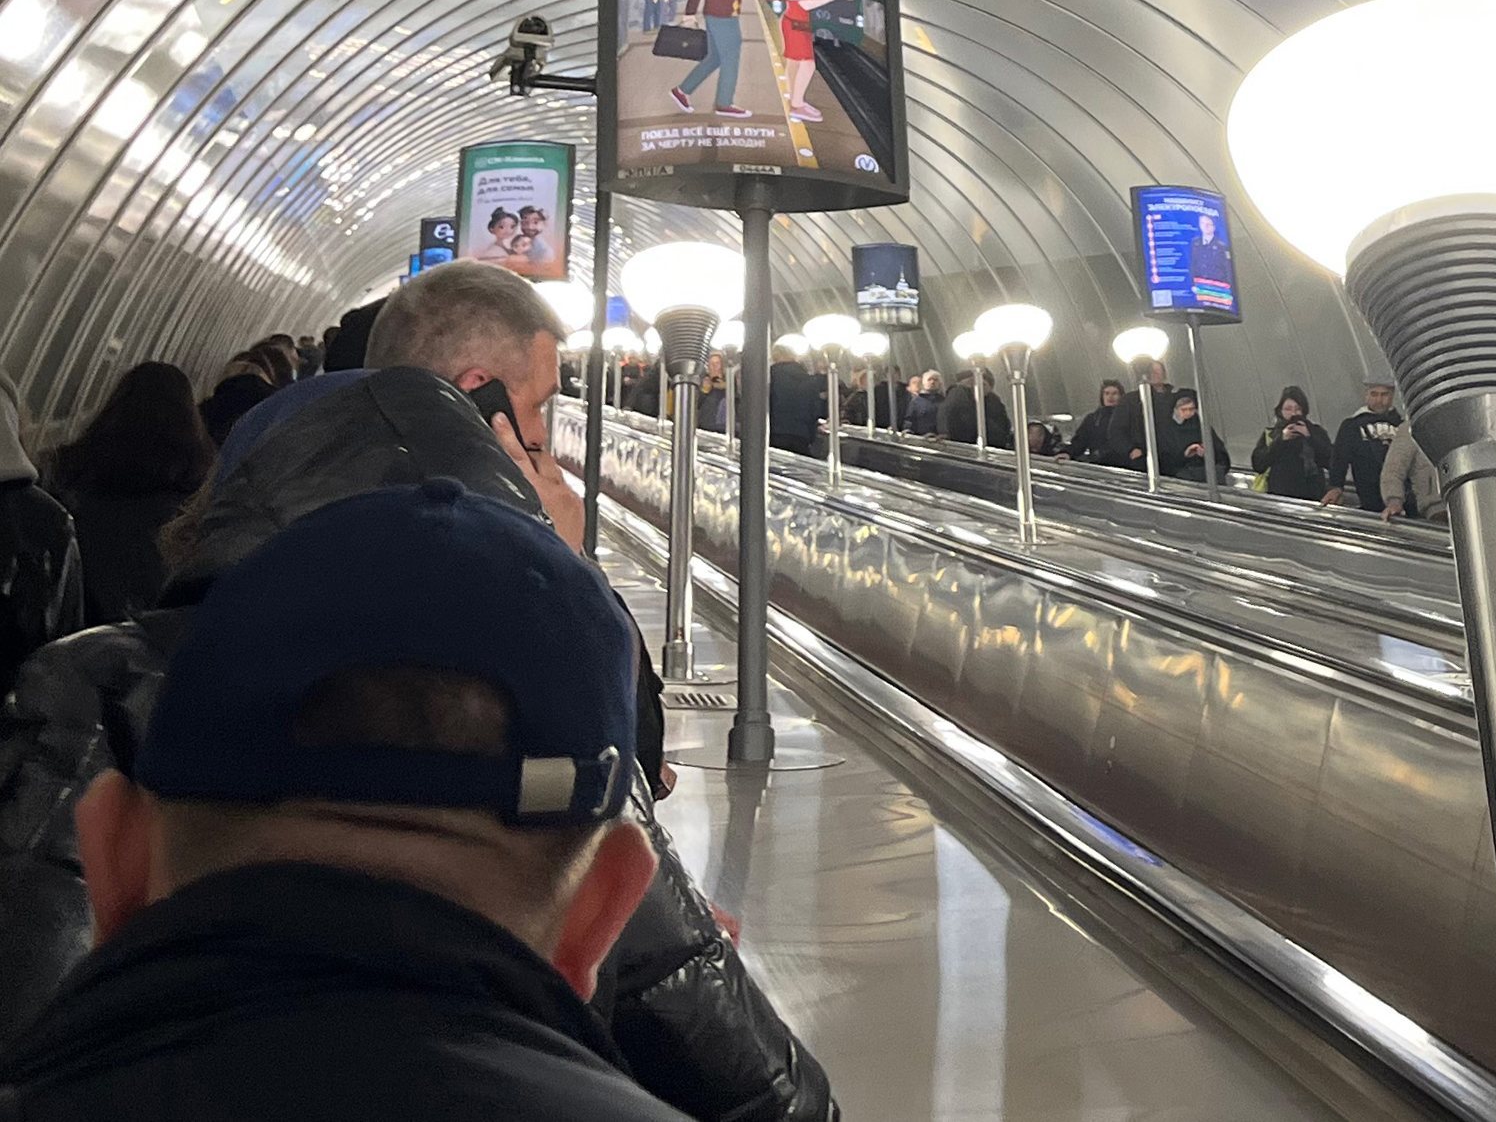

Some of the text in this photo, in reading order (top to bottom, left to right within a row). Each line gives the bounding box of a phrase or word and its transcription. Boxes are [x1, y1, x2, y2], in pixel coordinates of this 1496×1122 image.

[641, 128, 680, 140] ПОЕЗД
[733, 126, 741, 136] В
[744, 127, 775, 138] ПУТИ
[641, 141, 656, 151] ЗА
[657, 139, 695, 149] ЧЕРТУ
[697, 138, 713, 147] НЕ
